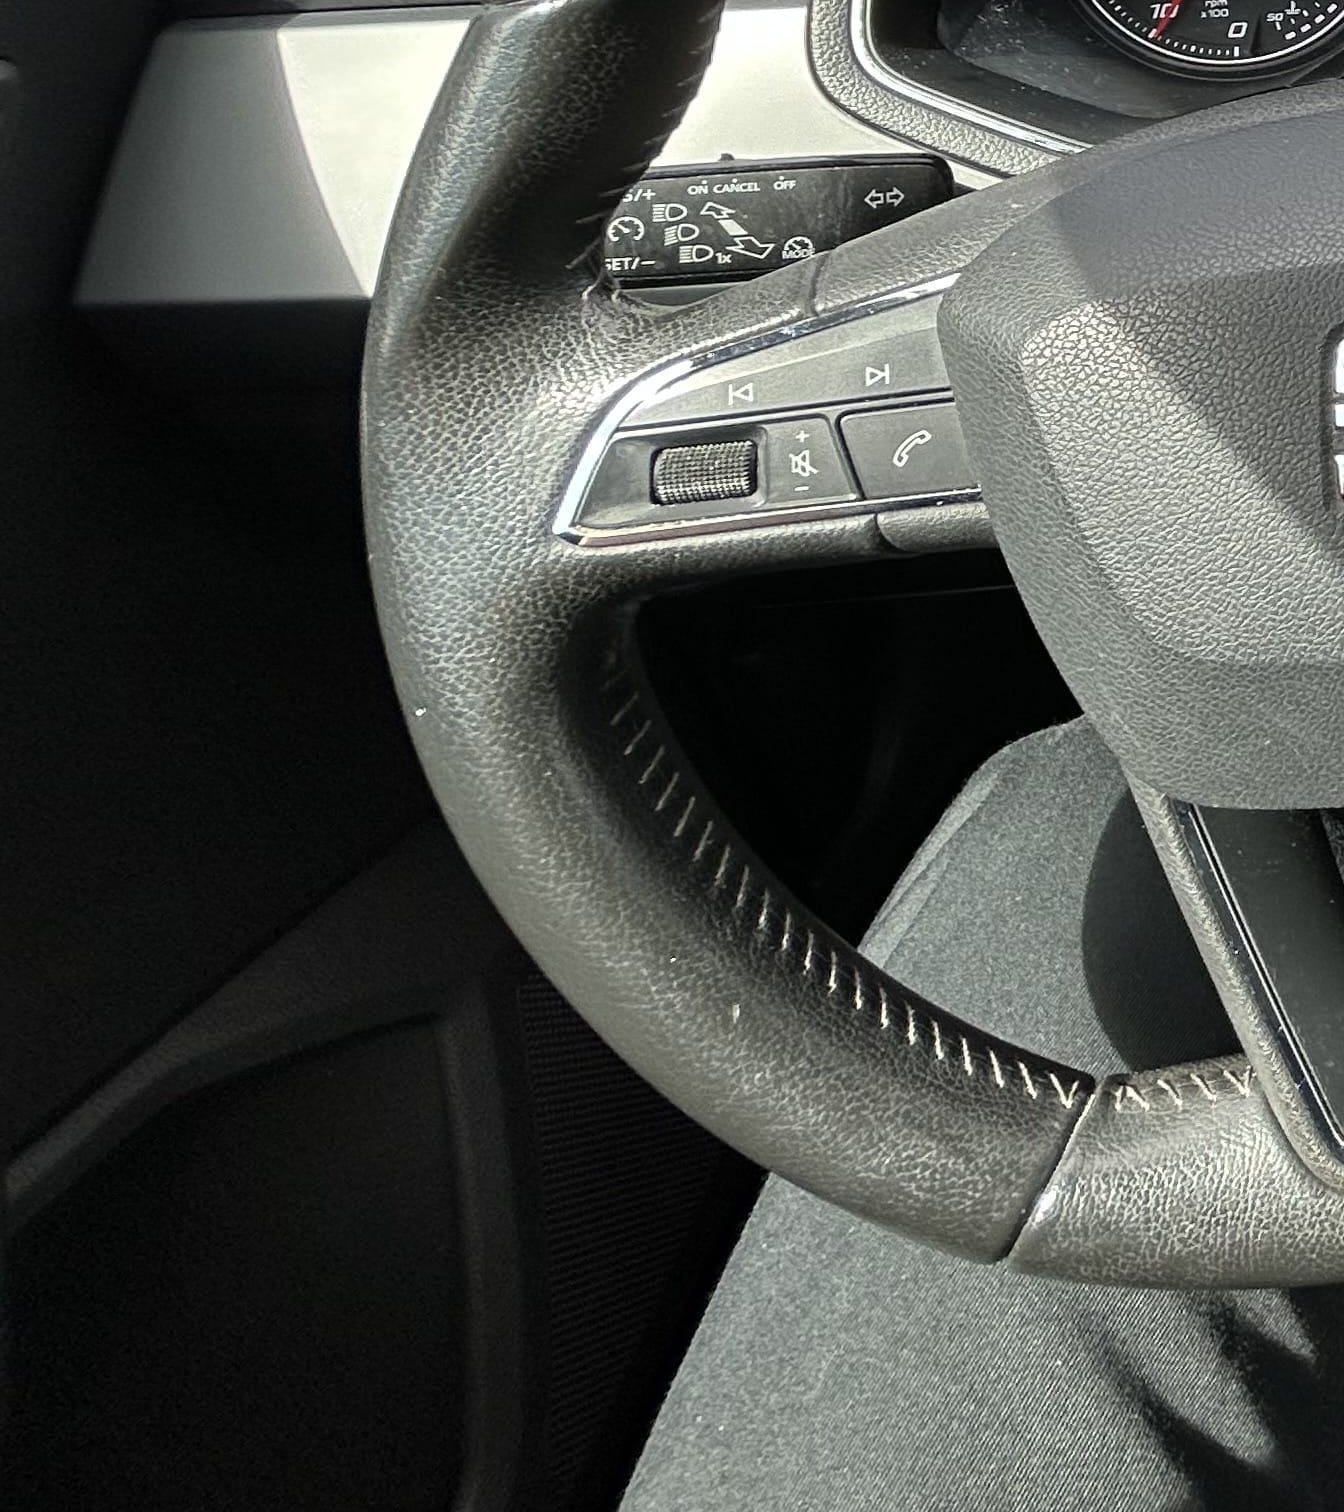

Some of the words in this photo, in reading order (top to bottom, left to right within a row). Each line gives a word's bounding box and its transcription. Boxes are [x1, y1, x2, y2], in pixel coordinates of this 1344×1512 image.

[1205, 0, 1228, 8] rpm
[1150, 4, 1179, 19] 10
[1266, 13, 1283, 22] 50
[1228, 22, 1248, 38] 0
[687, 185, 708, 195] ON
[713, 183, 760, 194] CANCEL
[773, 181, 796, 191] OFF
[715, 252, 732, 264] 1x
